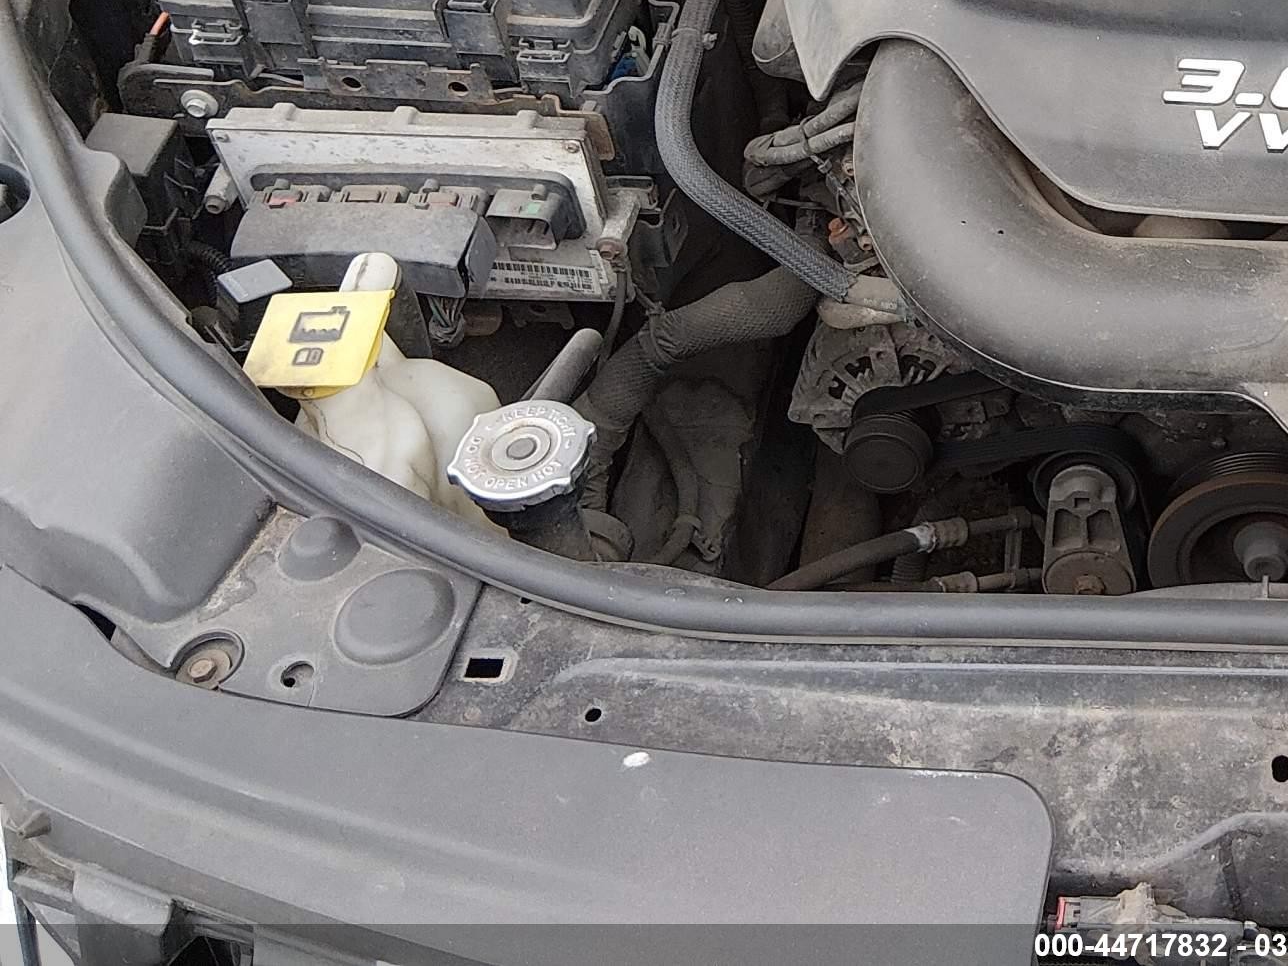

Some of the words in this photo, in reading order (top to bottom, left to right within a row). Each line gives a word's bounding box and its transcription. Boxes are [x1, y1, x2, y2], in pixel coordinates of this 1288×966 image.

[502, 406, 547, 422] KEEP
[464, 458, 486, 480] NOT
[484, 476, 529, 490] OPEN
[531, 459, 562, 483] HOT
